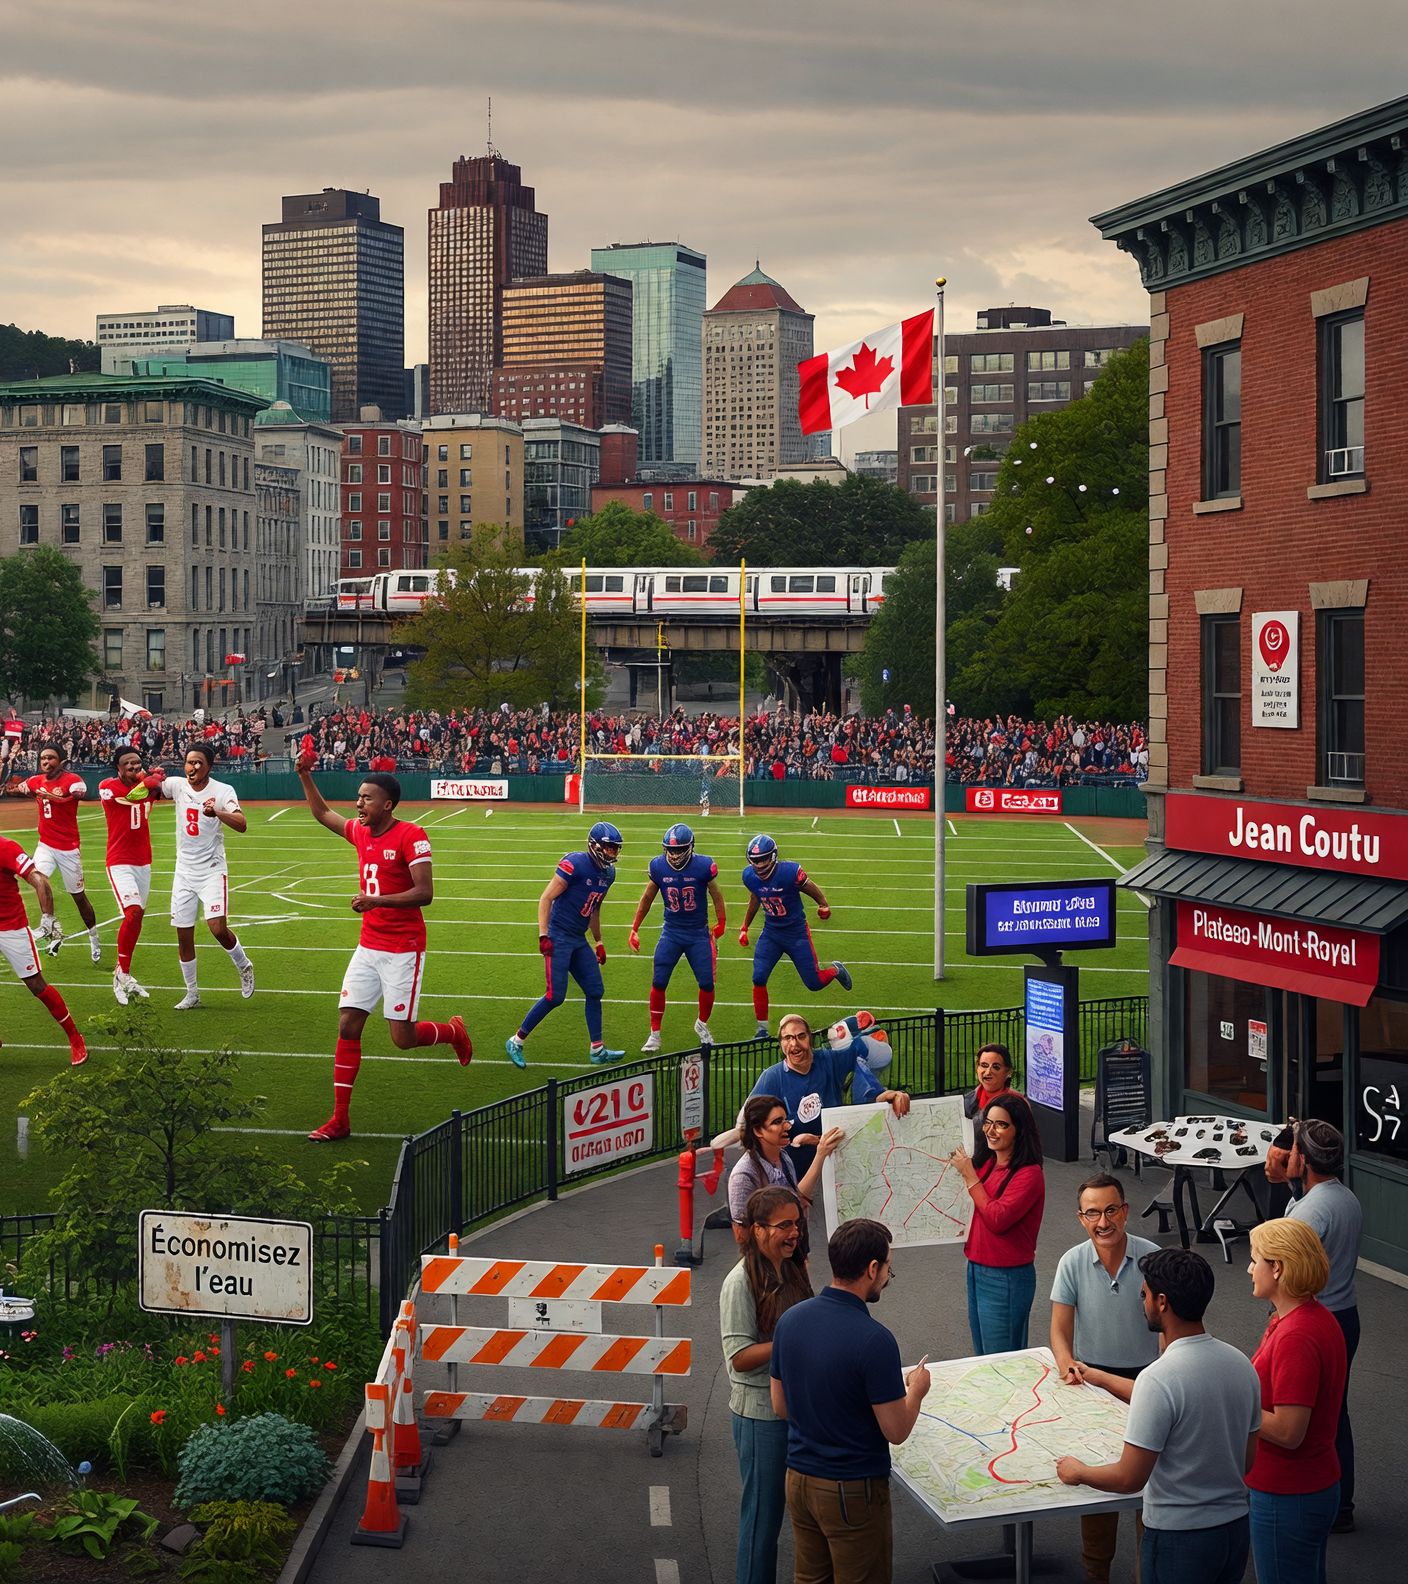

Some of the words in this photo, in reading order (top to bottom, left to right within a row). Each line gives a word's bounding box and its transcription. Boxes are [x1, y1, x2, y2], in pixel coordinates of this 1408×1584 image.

[1228, 807, 1292, 853] Jean
[1299, 814, 1380, 864] Coutu
[151, 1223, 301, 1266] Économisez
[195, 1266, 253, 1296] l'eau
